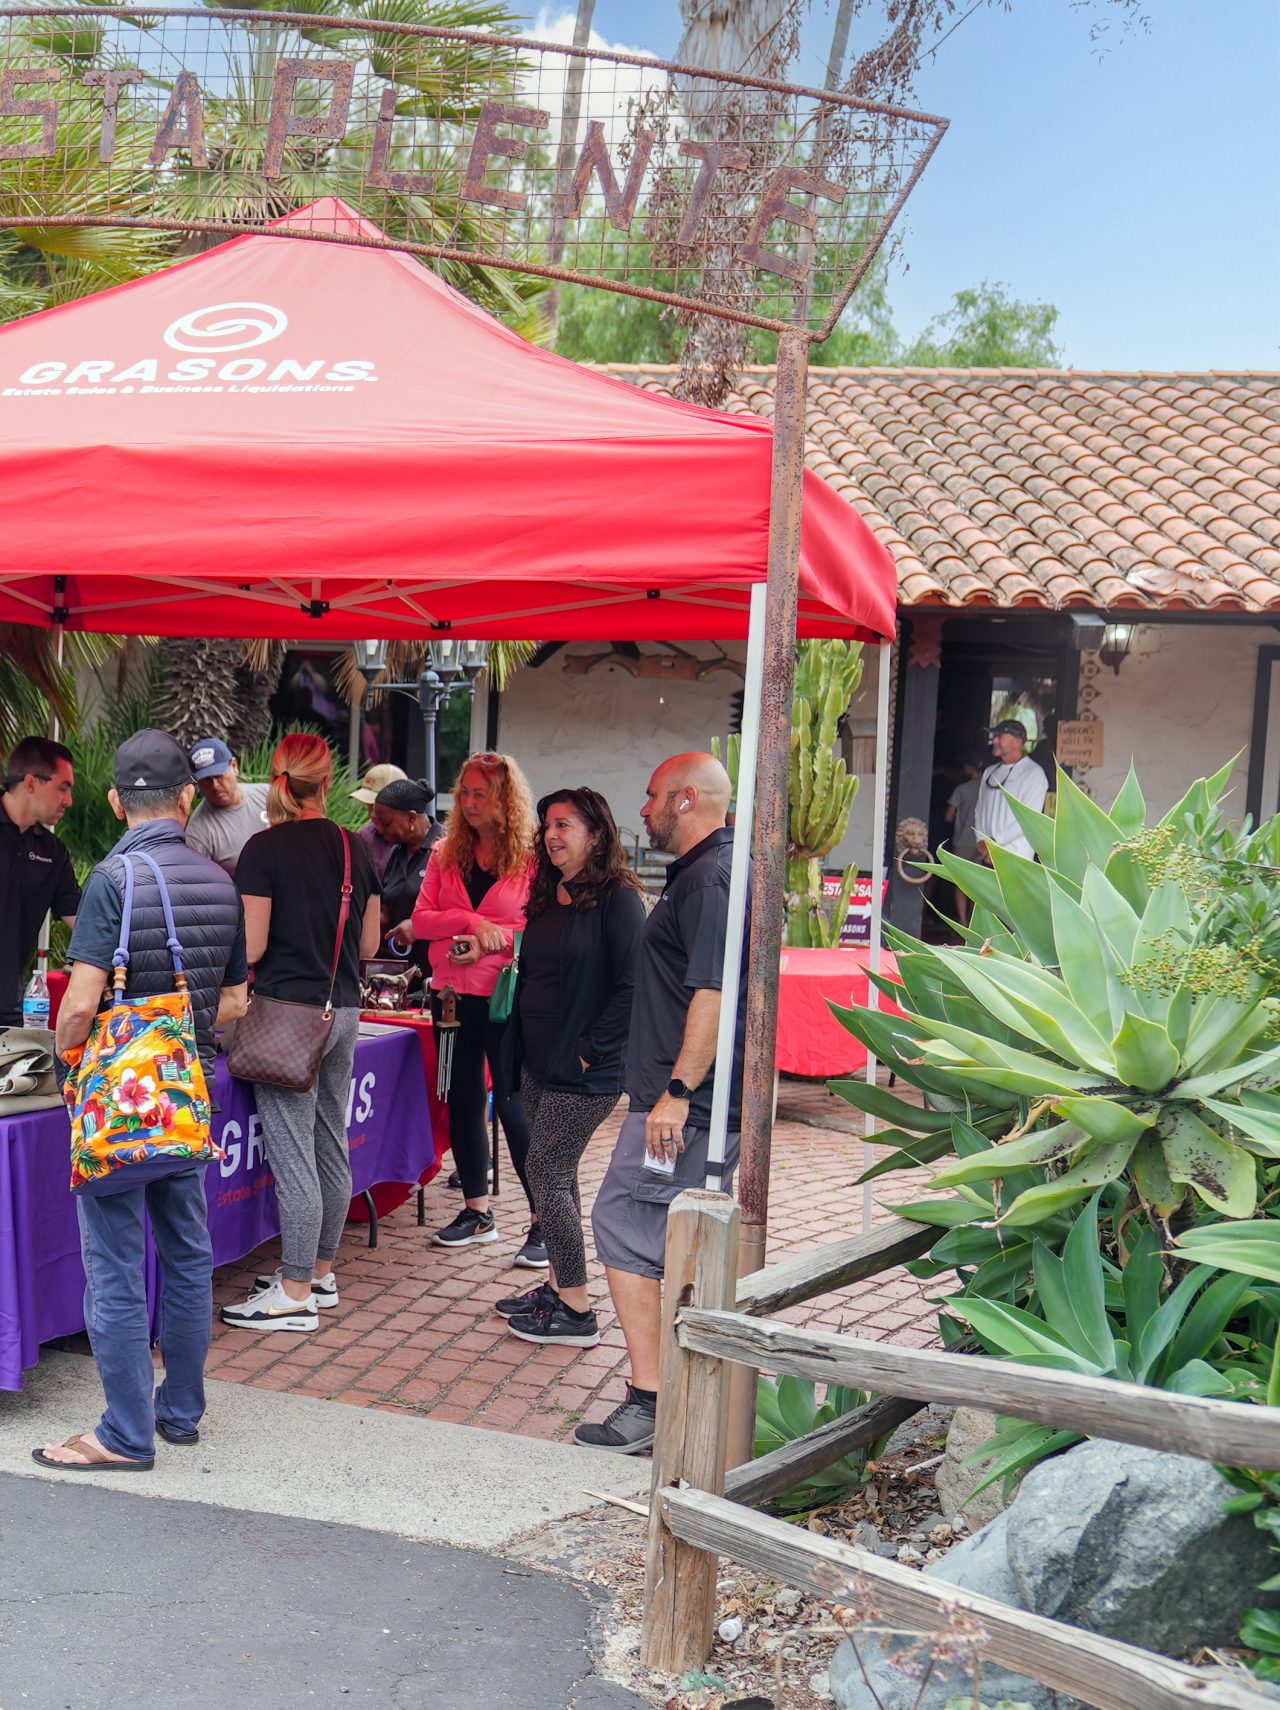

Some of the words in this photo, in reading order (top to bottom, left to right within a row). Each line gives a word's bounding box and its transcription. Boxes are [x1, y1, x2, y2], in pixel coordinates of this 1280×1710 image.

[262, 57, 847, 283] PLENTE
[19, 358, 378, 385] GRASONS
[1, 387, 61, 397] Estate
[65, 386, 116, 396] Sales
[120, 385, 133, 395] &
[138, 385, 223, 395] Business
[228, 383, 355, 395] Liquidations
